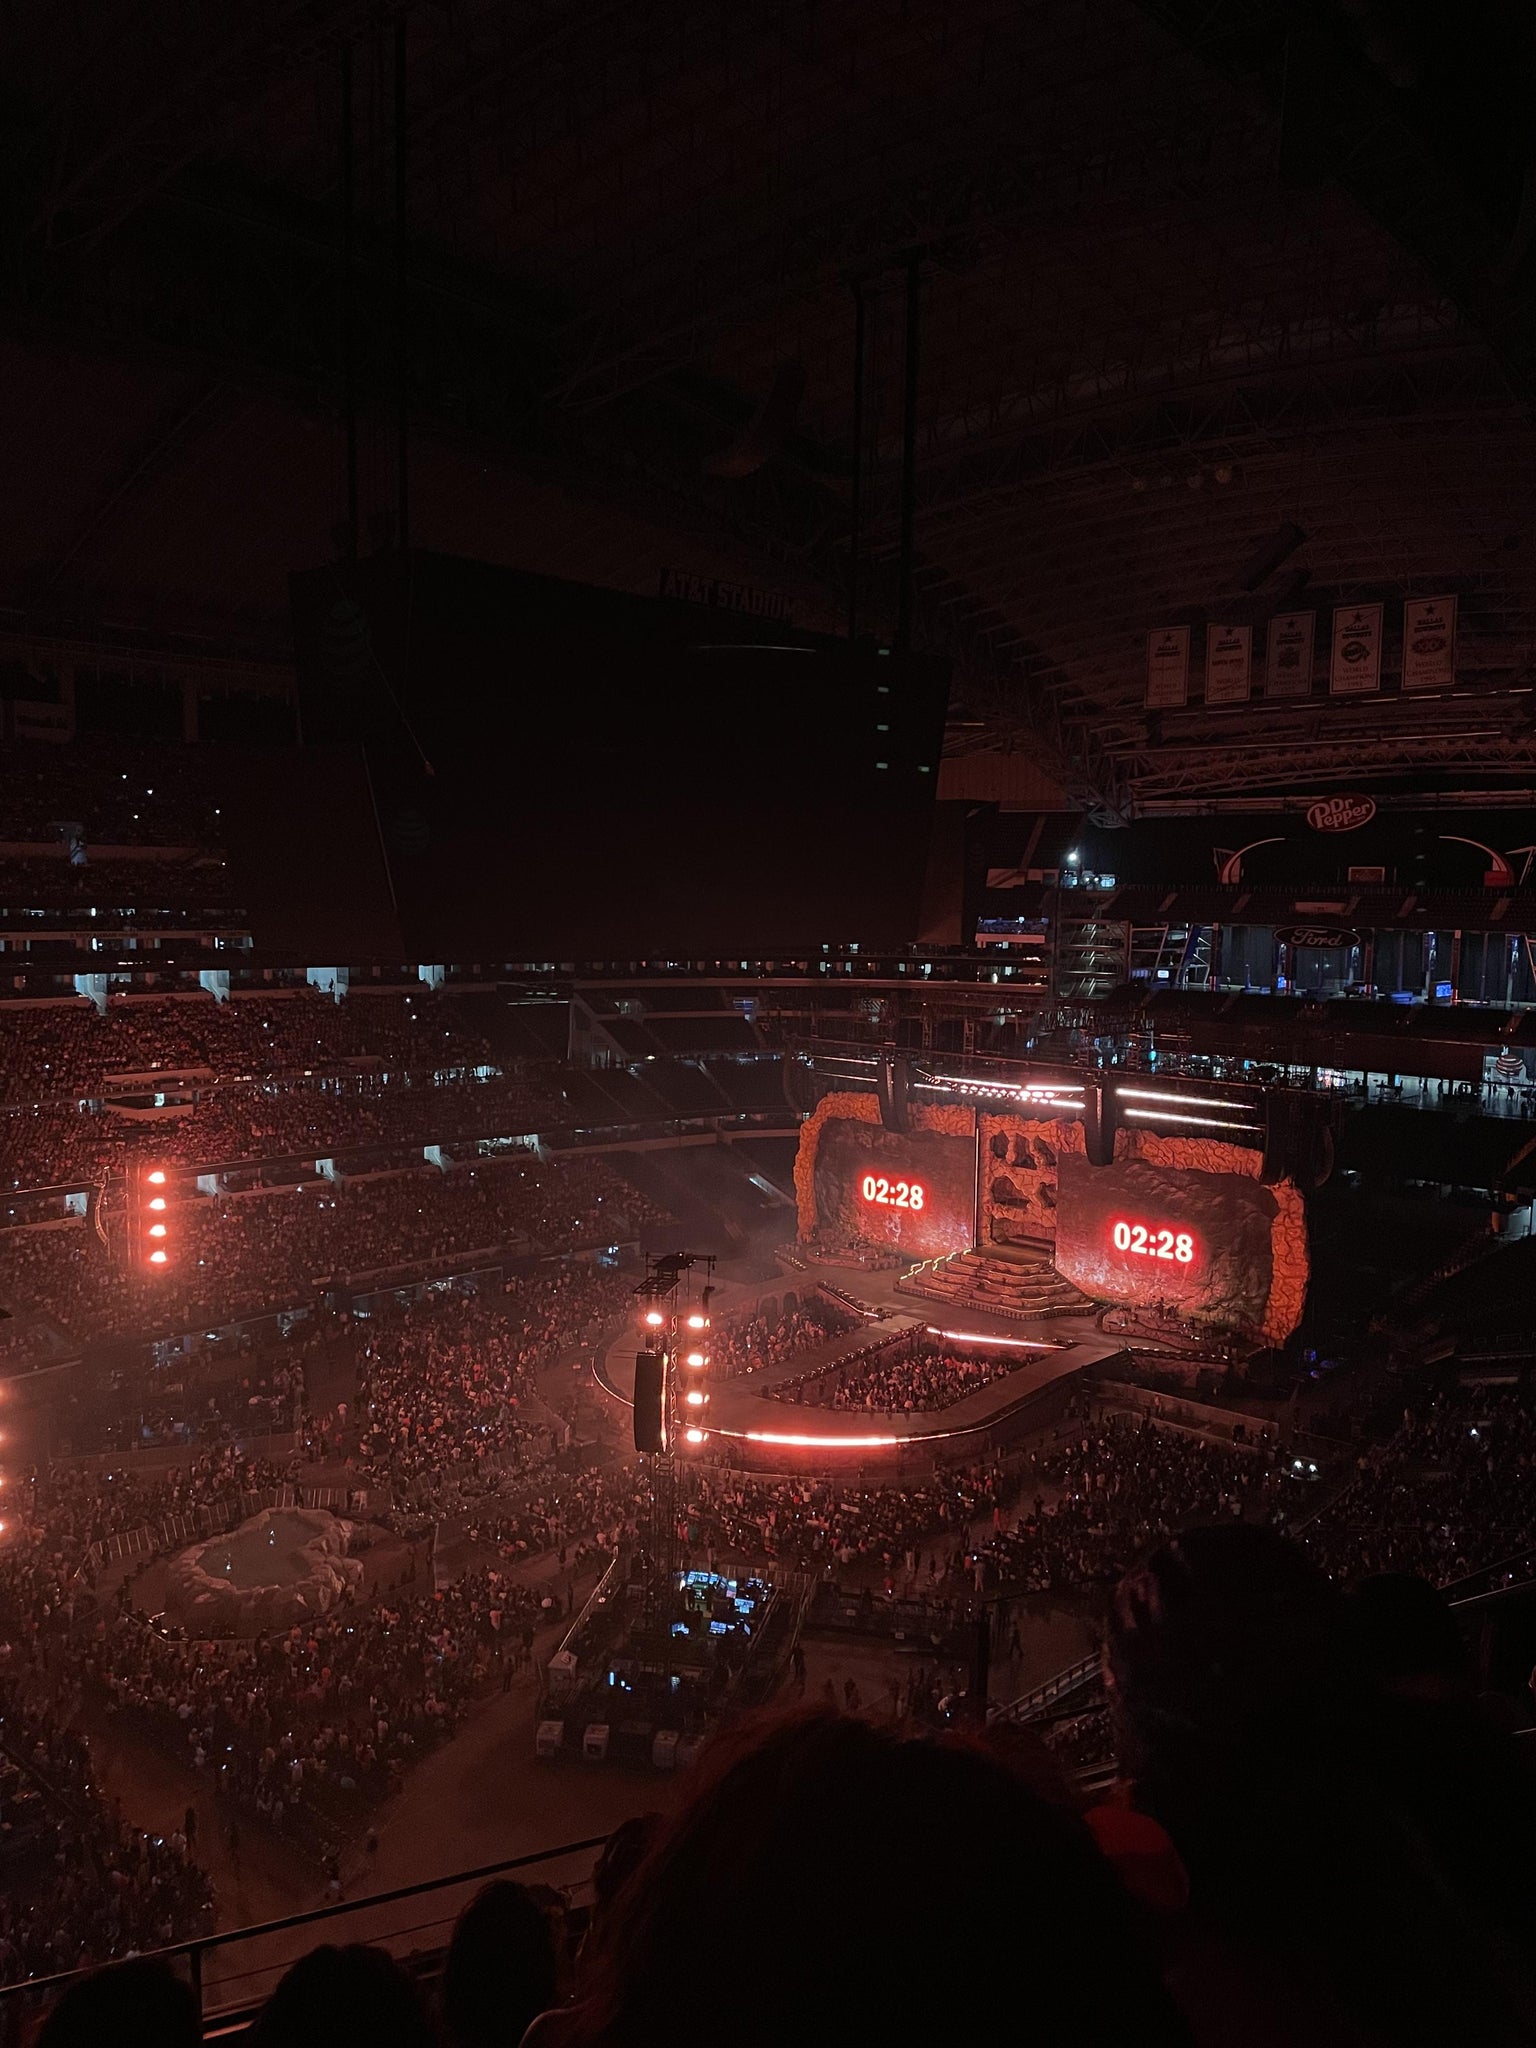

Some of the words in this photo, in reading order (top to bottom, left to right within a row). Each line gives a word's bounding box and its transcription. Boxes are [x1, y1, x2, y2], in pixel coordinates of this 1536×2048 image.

[1314, 802, 1370, 829] Pepper
[1330, 798, 1354, 814] Dr
[1290, 927, 1343, 946] Ford
[863, 1176, 924, 1210] 02:28
[1113, 1222, 1194, 1263] 02:28
